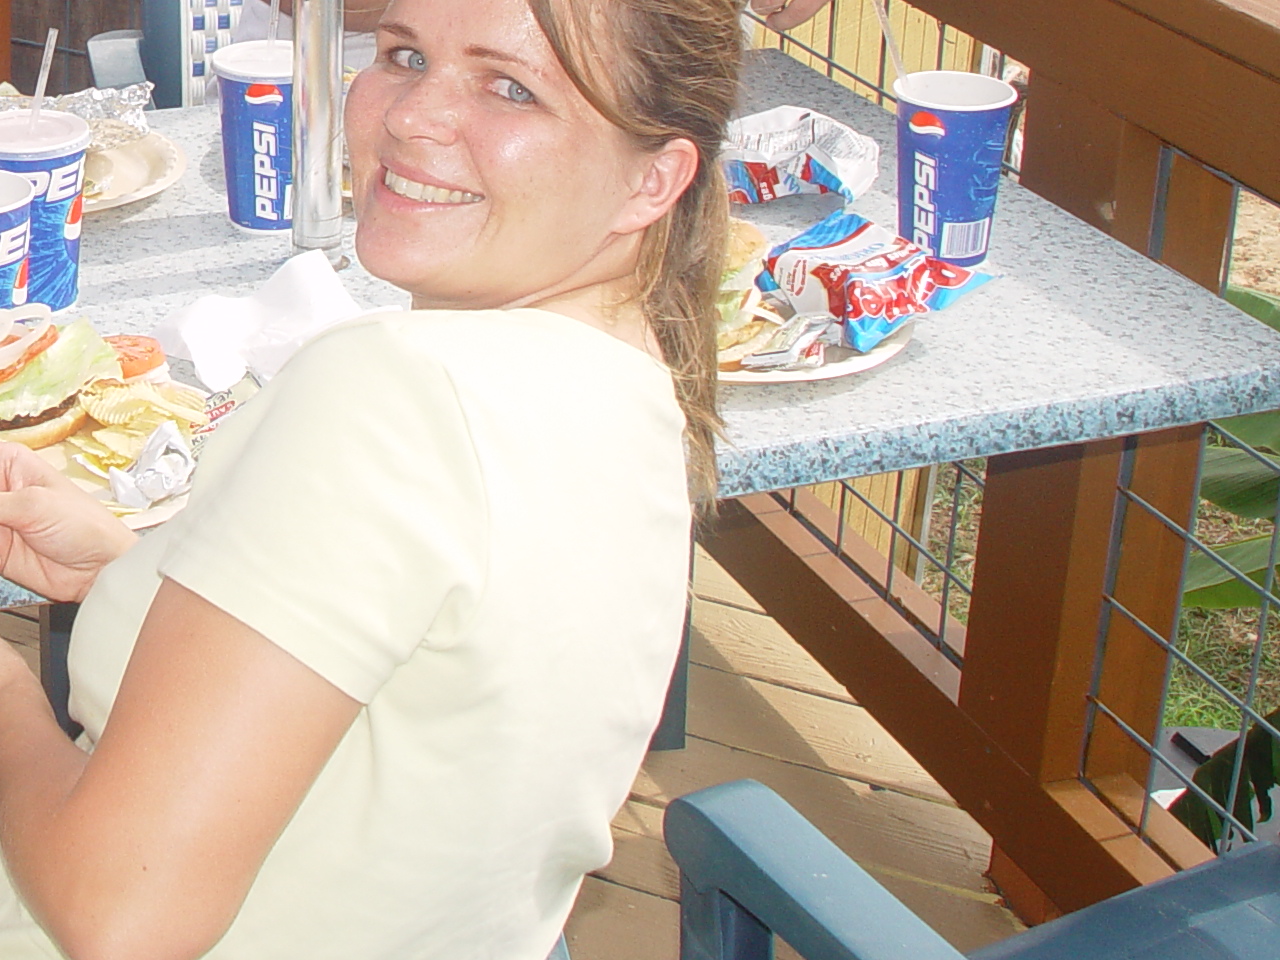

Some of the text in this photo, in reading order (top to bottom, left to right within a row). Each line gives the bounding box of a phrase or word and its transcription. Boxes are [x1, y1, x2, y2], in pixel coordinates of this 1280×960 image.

[19, 154, 87, 203] PE
[252, 120, 279, 221] PEPSI
[913, 150, 937, 258] PEPSI
